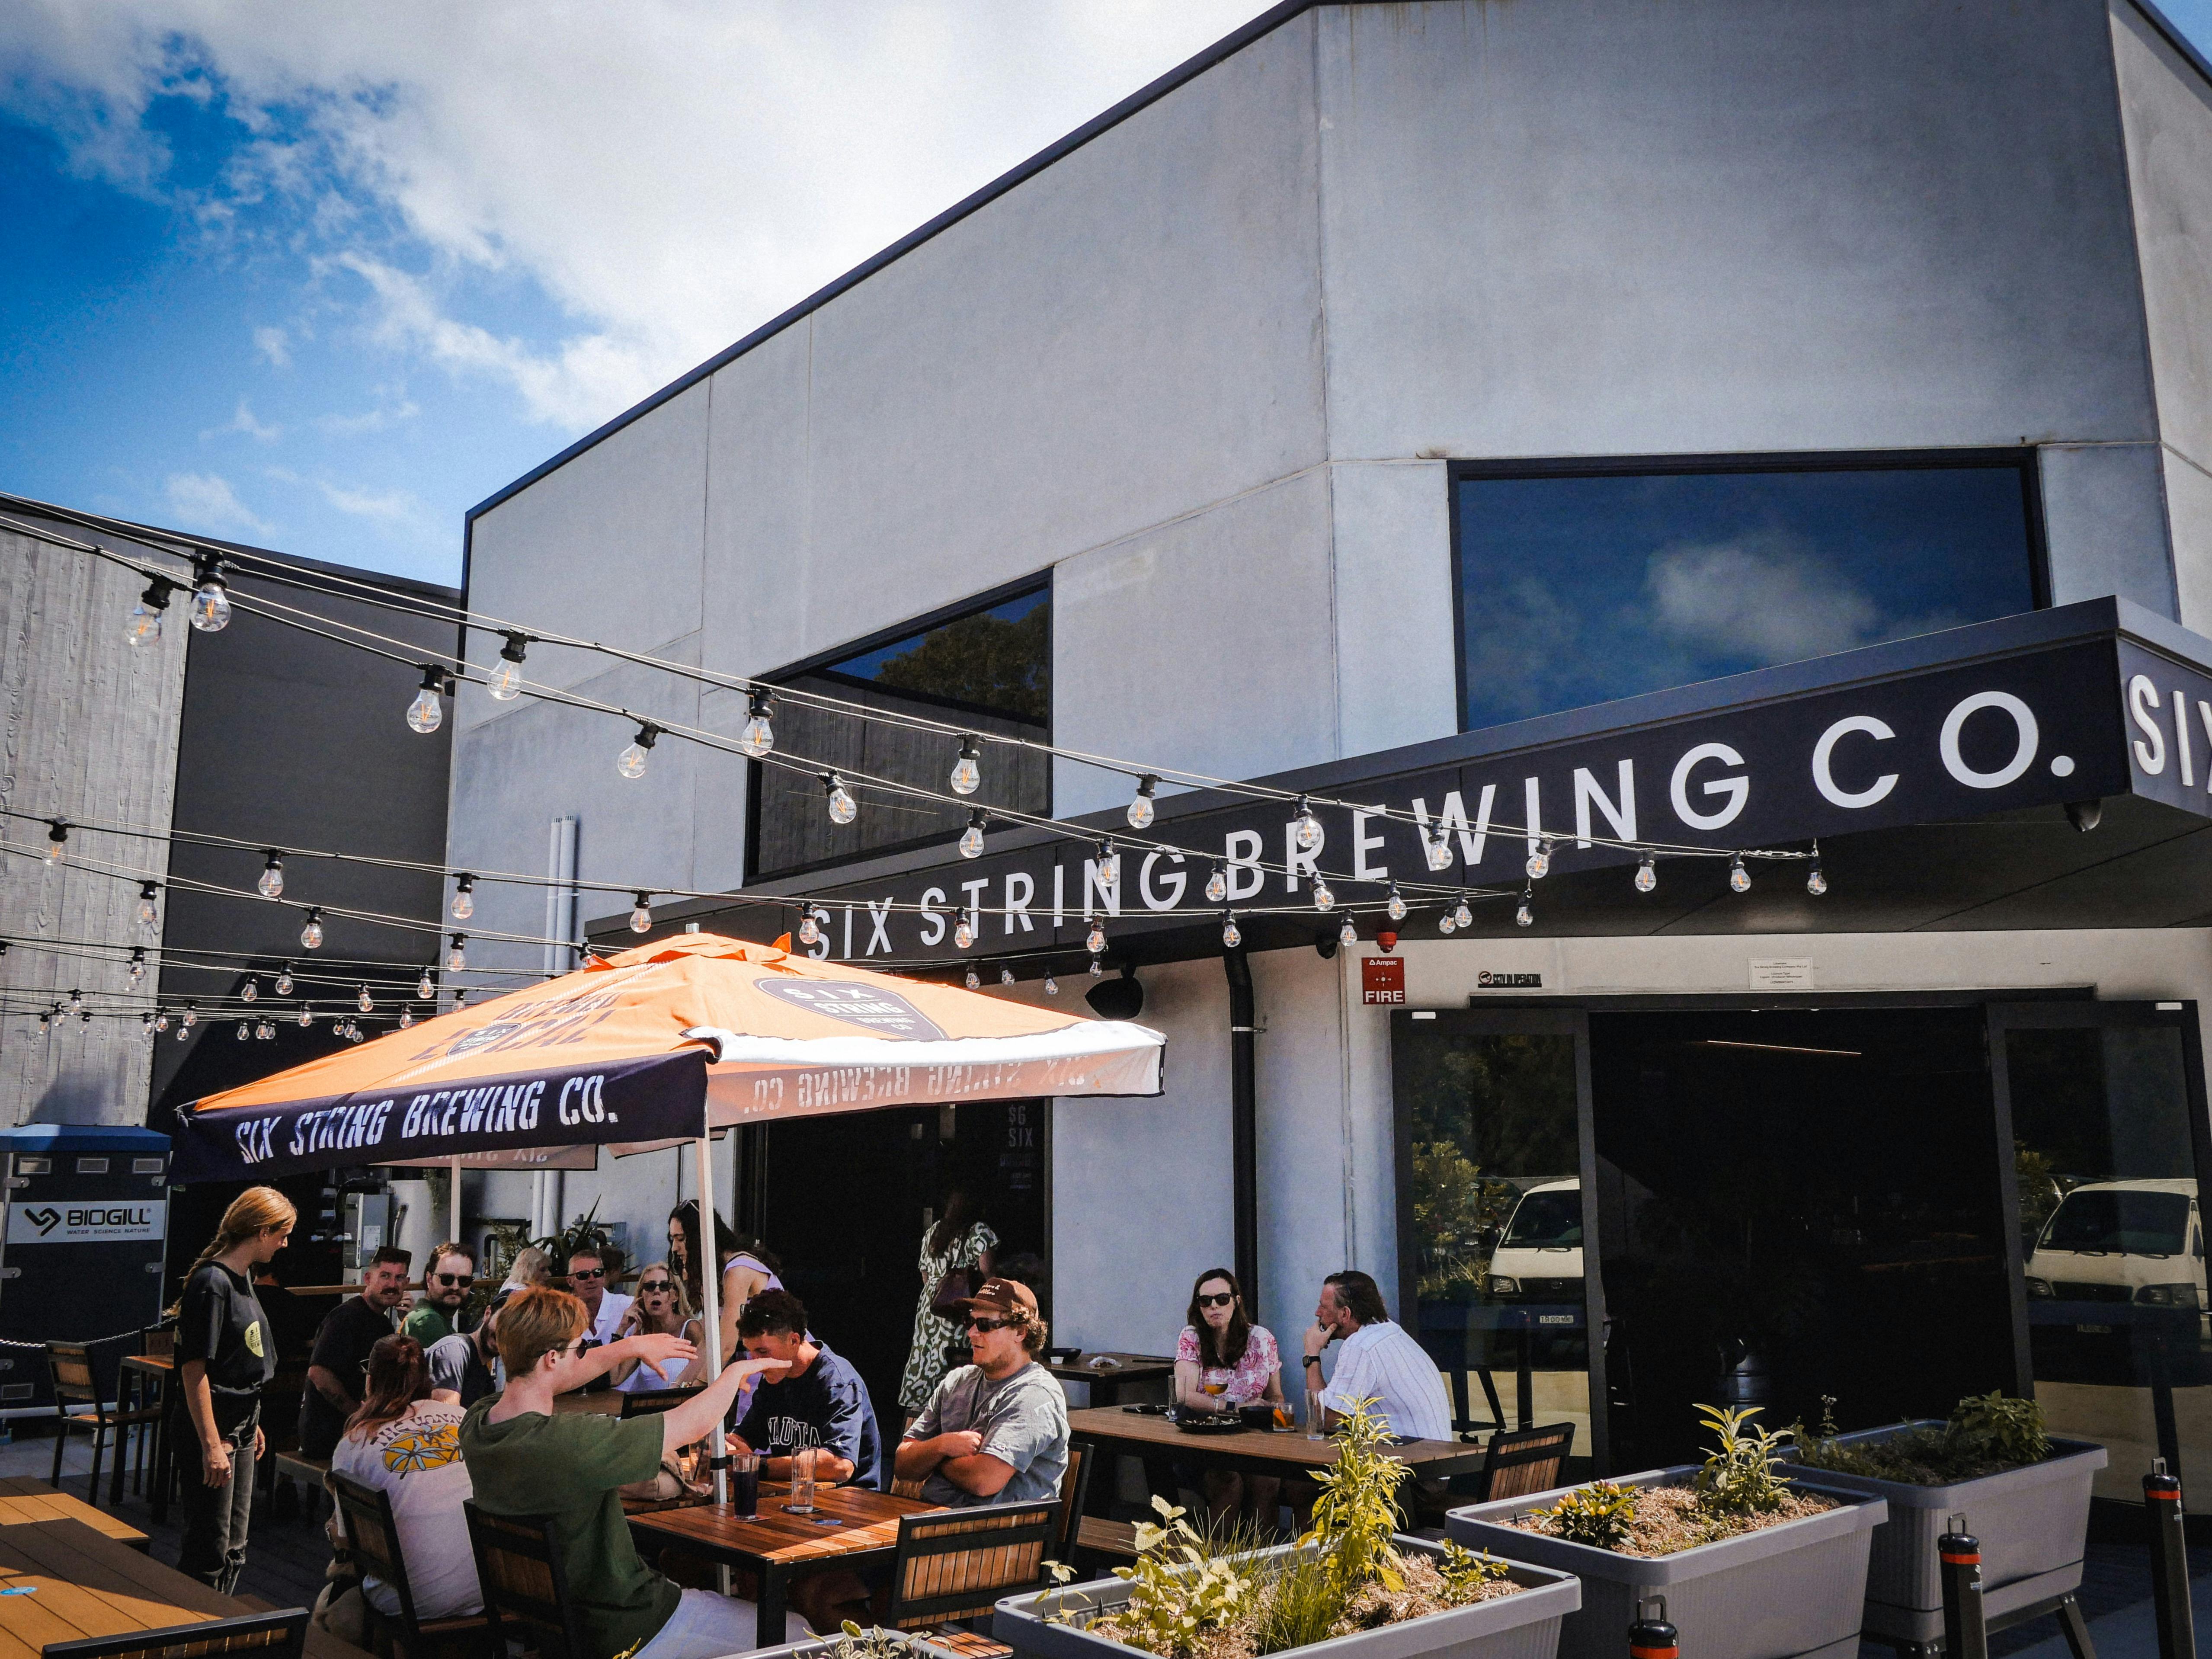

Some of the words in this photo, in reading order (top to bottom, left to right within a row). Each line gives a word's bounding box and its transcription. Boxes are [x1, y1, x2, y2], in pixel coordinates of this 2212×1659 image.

[807, 896, 893, 960] SIX
[921, 849, 1186, 946] STRING
[1226, 743, 1749, 902] BREWING
[1812, 691, 2075, 808] CO.
[1493, 974, 1506, 984] CCTV
[1507, 974, 1513, 984] IN
[1514, 974, 1541, 984] OPERATION
[783, 988, 876, 999] SIX
[1365, 990, 1403, 1002] FIRE
[813, 1002, 906, 1014] STRING
[236, 1116, 282, 1164] SIX
[290, 1099, 394, 1156] STRING
[402, 1080, 546, 1138] BREWING
[560, 1075, 618, 1125] CO.
[1009, 1127, 1033, 1147] SIX
[67, 1208, 150, 1226] BIOGILL
